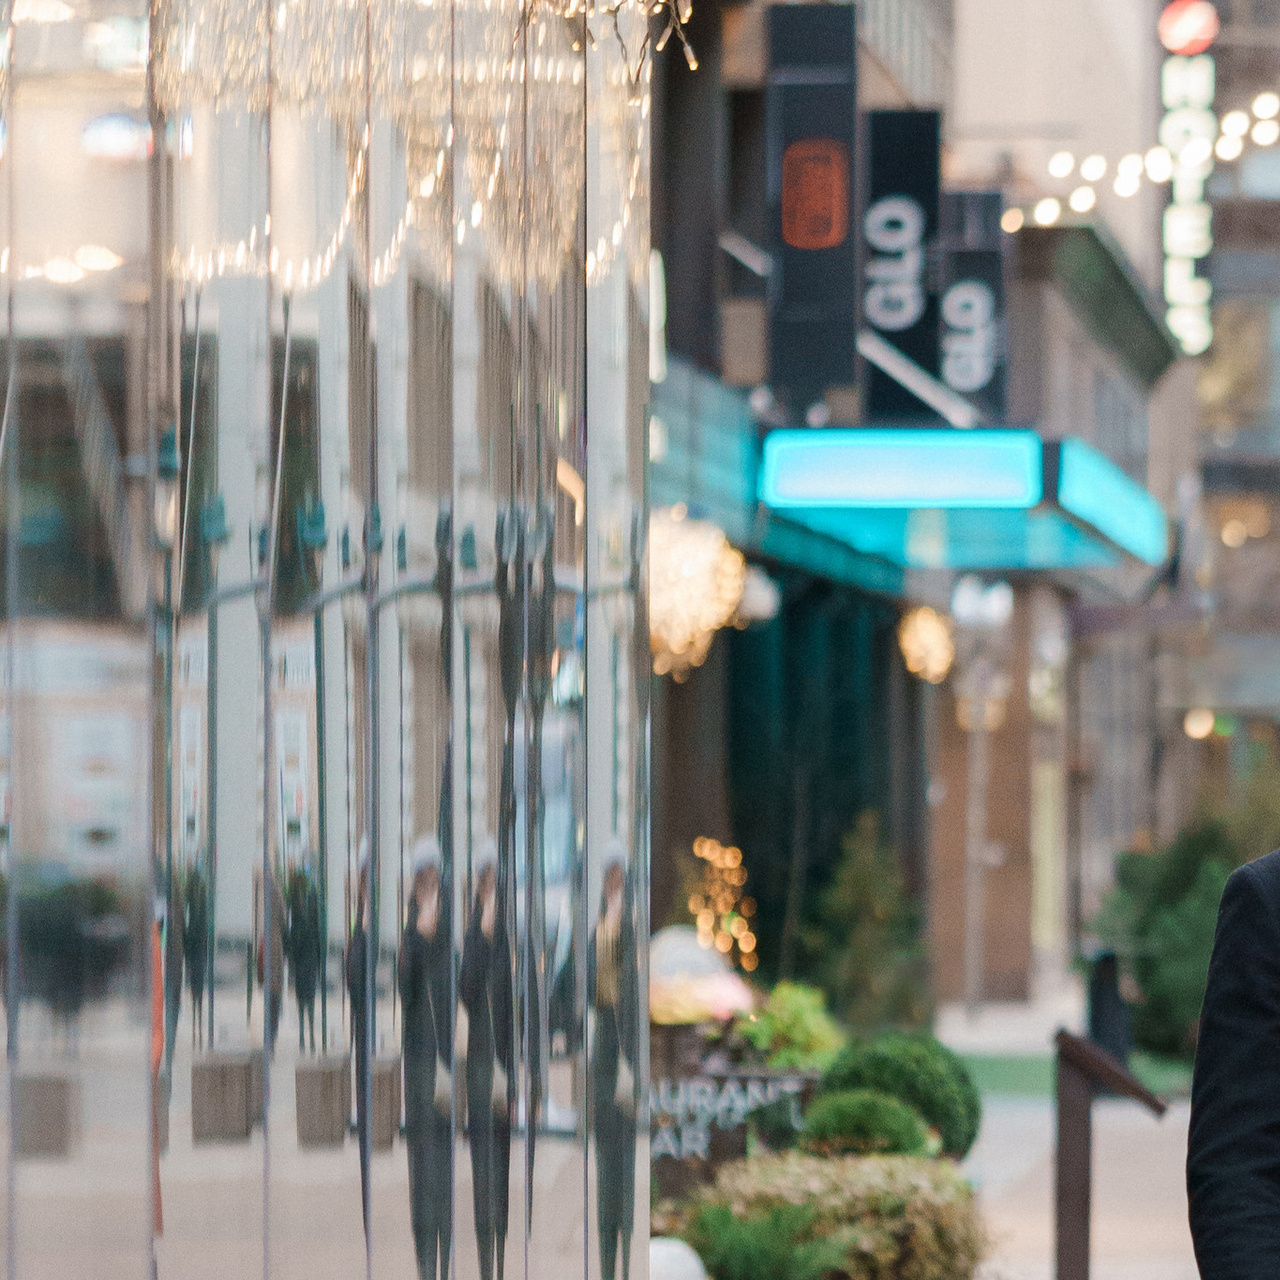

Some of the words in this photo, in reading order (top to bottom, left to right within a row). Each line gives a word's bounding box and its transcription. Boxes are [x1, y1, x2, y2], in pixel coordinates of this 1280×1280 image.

[864, 192, 927, 331] GLO
[1158, 53, 1218, 356] HOTELS
[940, 278, 995, 393] GLO
